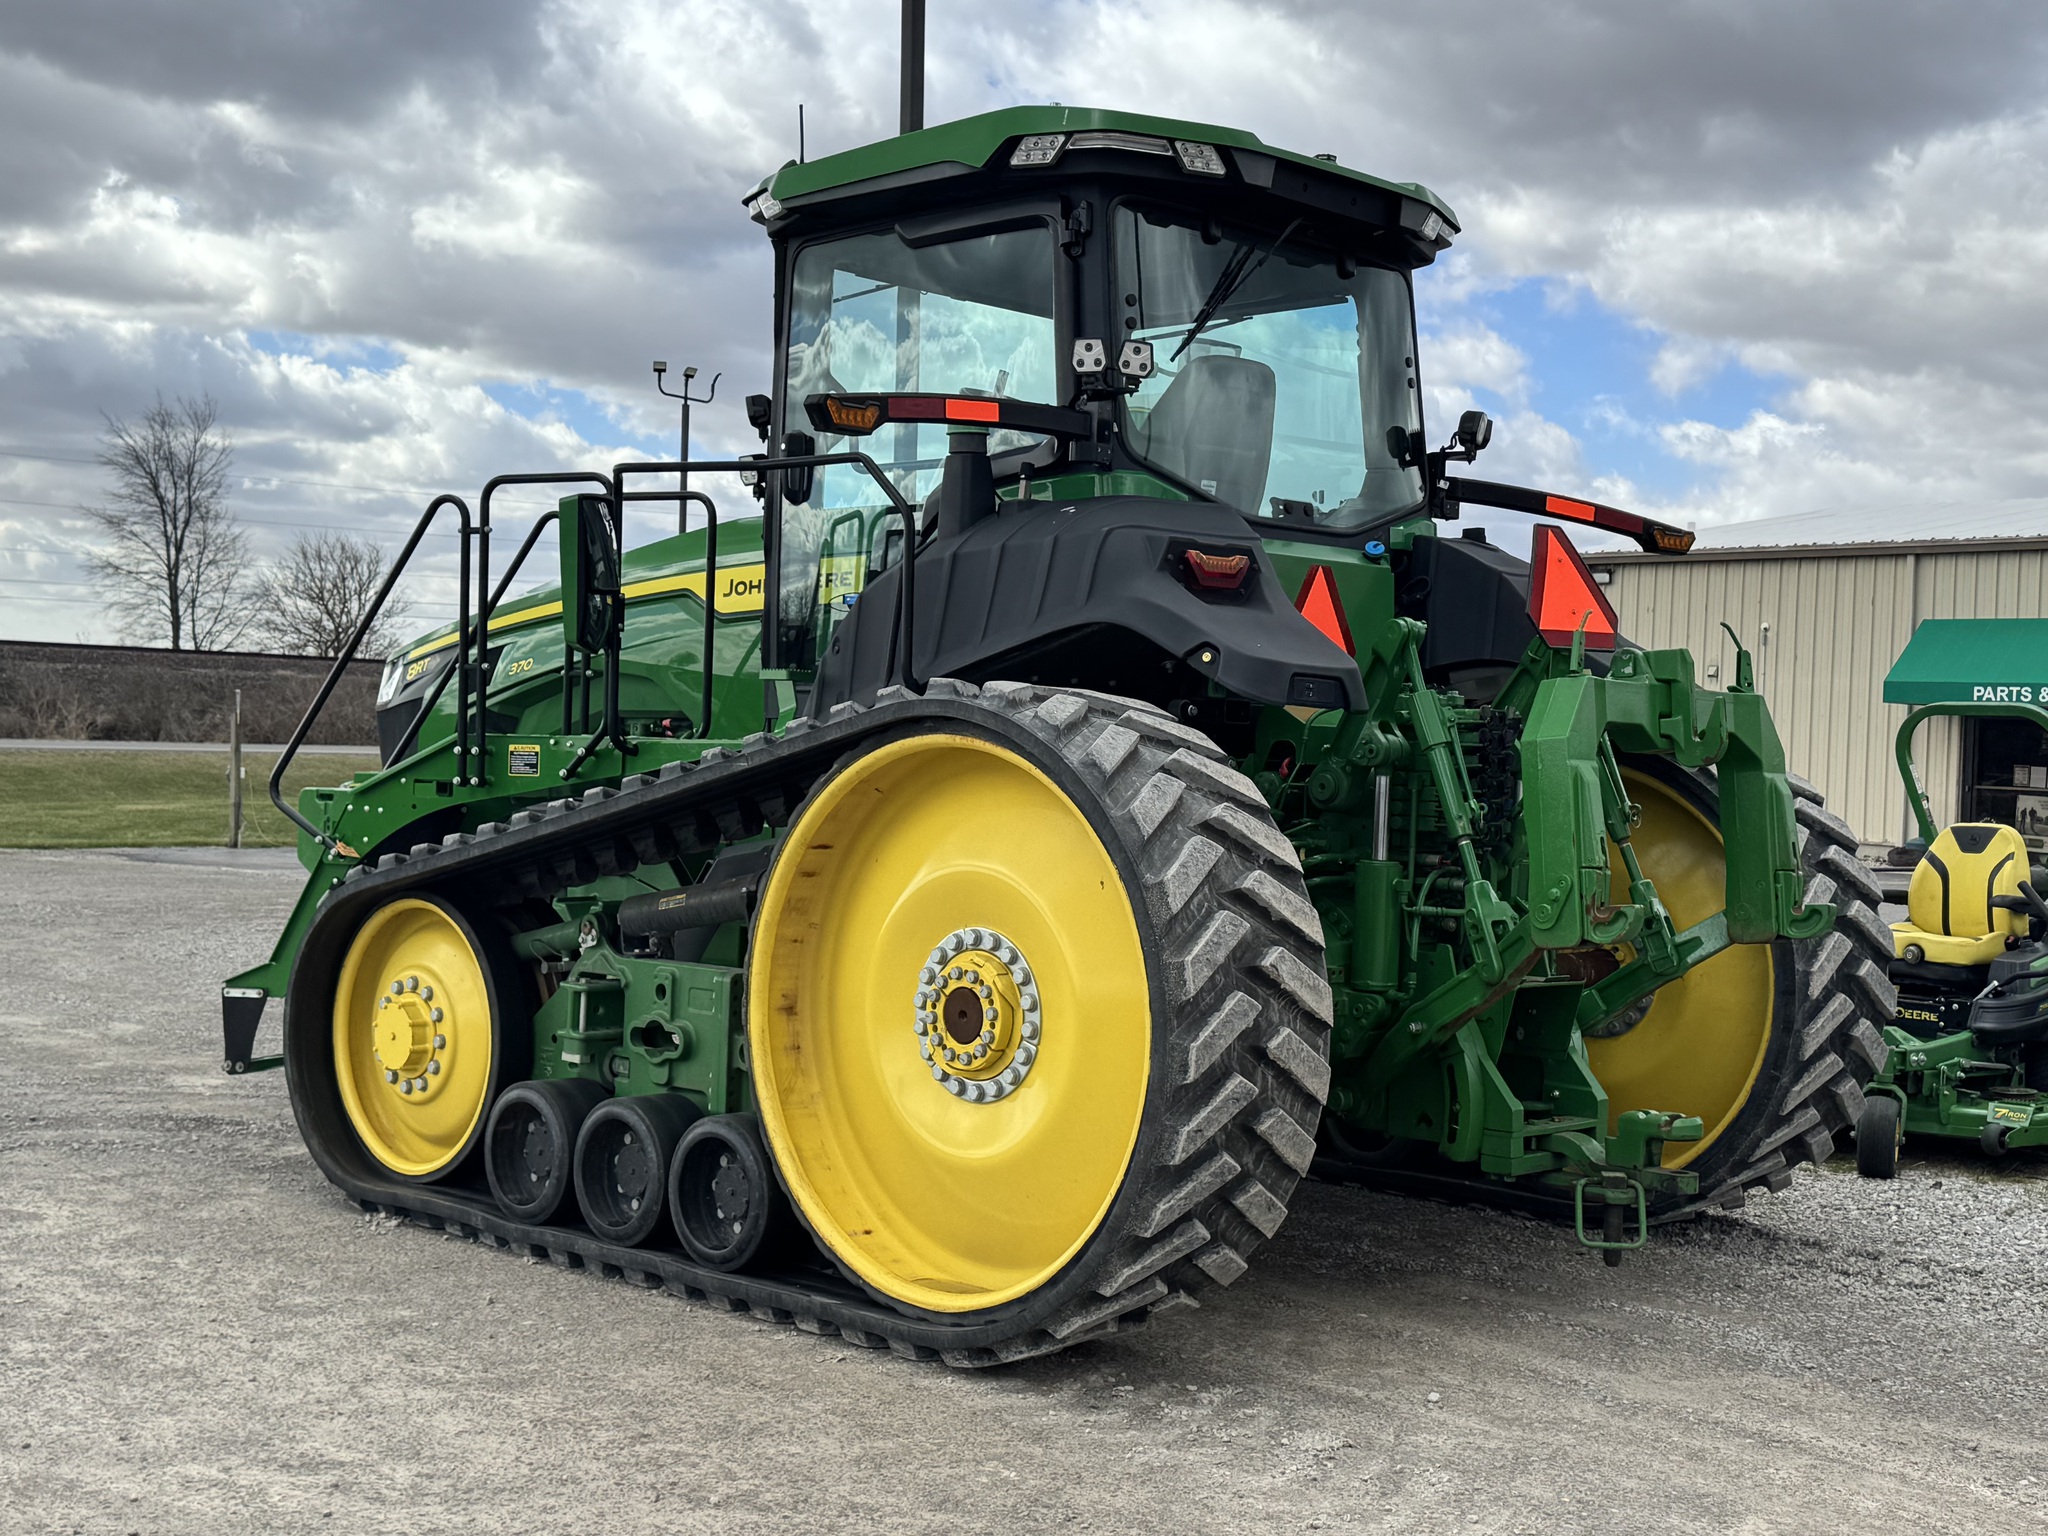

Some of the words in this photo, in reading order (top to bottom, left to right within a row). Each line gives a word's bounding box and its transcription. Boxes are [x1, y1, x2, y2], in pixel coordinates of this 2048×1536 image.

[723, 578, 765, 598] JOH
[406, 658, 431, 681] 8RT
[508, 658, 533, 676] 370
[1973, 686, 2032, 702] PARTS
